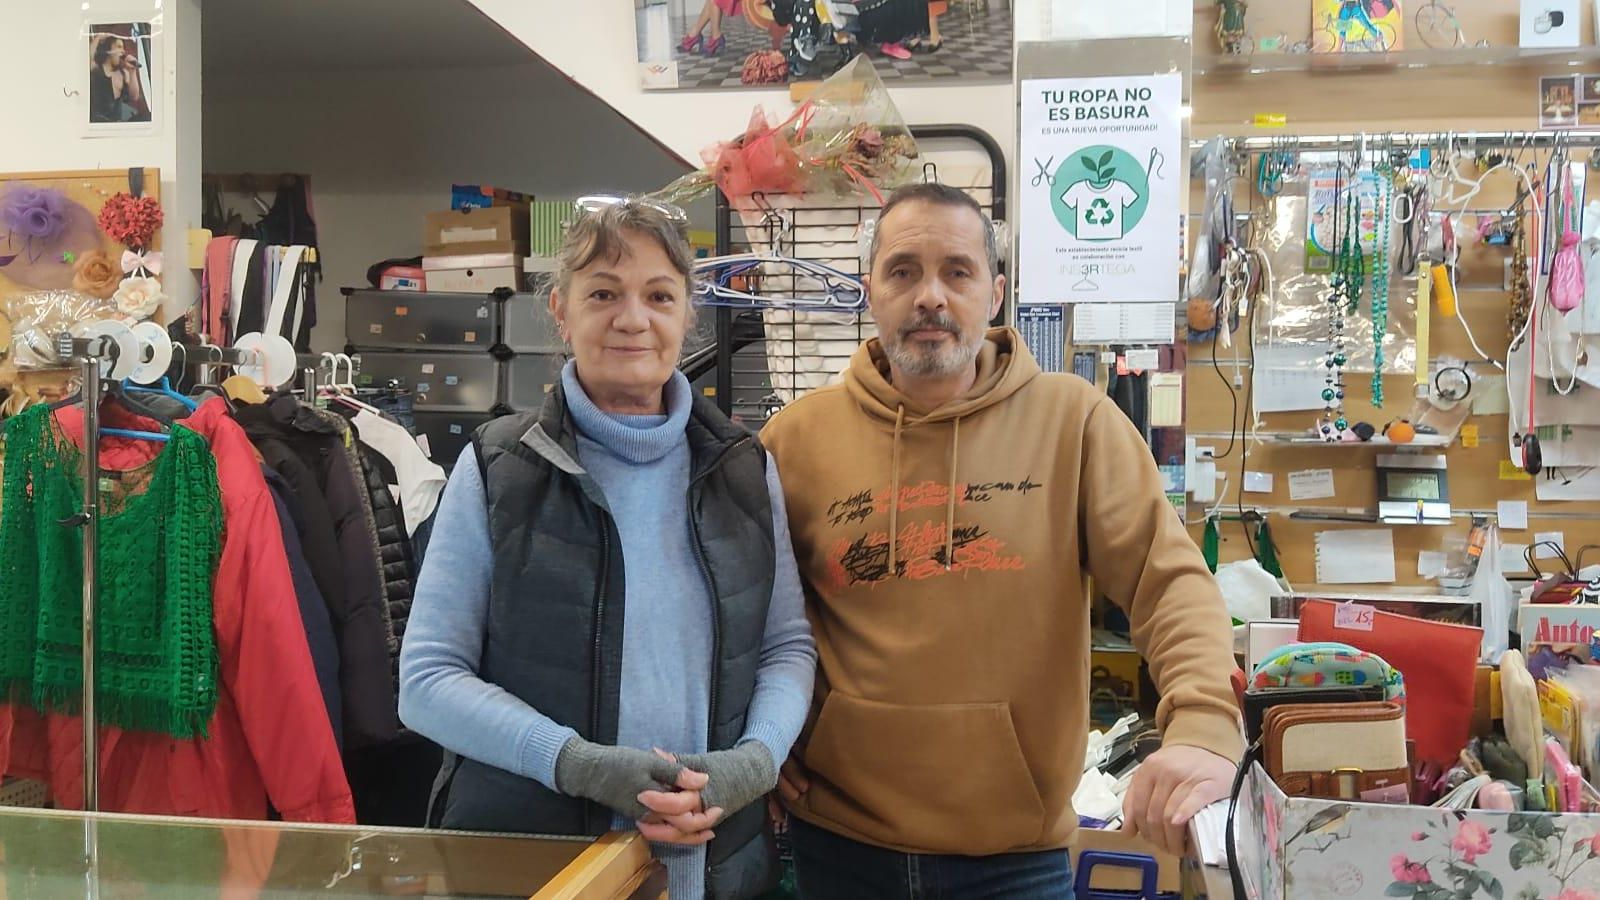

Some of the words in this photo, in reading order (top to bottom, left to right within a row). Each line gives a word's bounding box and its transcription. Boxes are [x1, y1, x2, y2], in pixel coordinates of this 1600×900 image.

[1041, 90, 1064, 104] TU
[1069, 88, 1119, 104] ROPA
[1125, 87, 1152, 102] NO
[1049, 107, 1070, 121] ES
[1075, 105, 1149, 120] BASURA
[1041, 127, 1051, 135] ES
[1053, 126, 1070, 135] UNA
[1071, 125, 1098, 134] NUEVA
